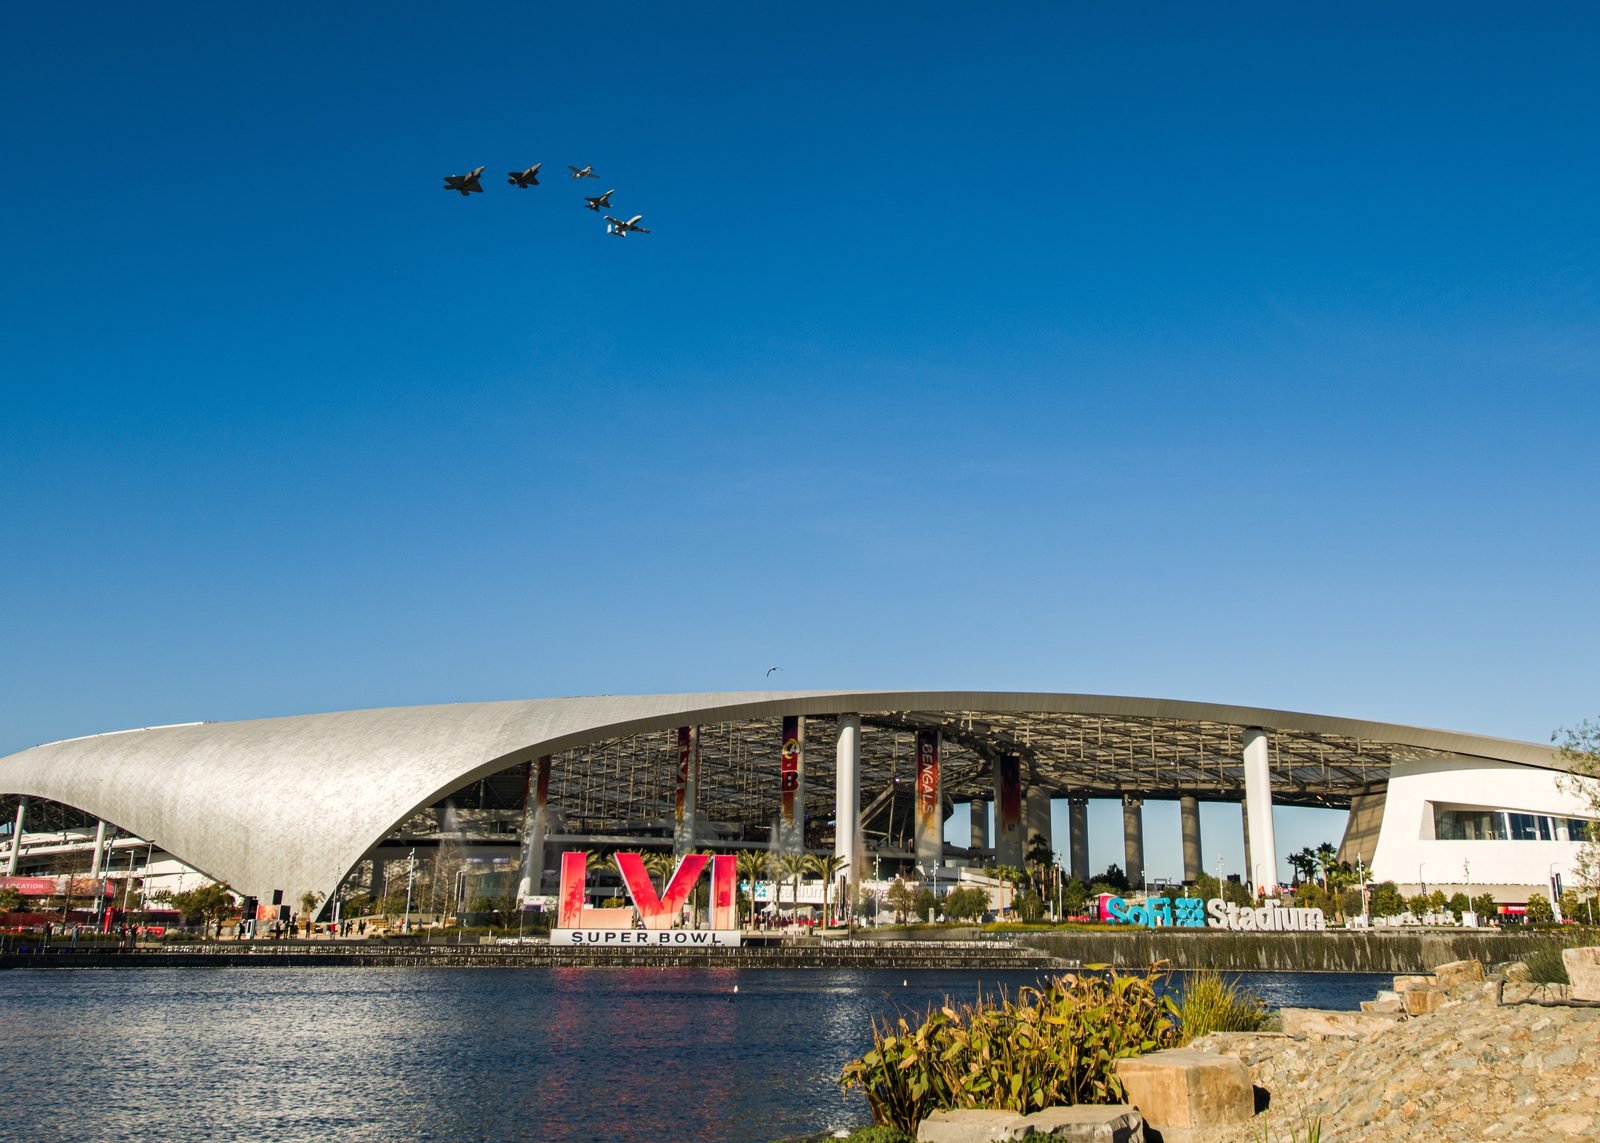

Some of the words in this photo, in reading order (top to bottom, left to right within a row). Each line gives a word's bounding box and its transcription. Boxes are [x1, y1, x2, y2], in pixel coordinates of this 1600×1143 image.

[922, 743, 934, 814] BENGALS
[558, 852, 737, 929] LVI
[1106, 897, 1171, 929] SoFi
[1207, 898, 1326, 931] Stadium
[571, 931, 649, 944] SUPER
[658, 932, 722, 945] BOWL
